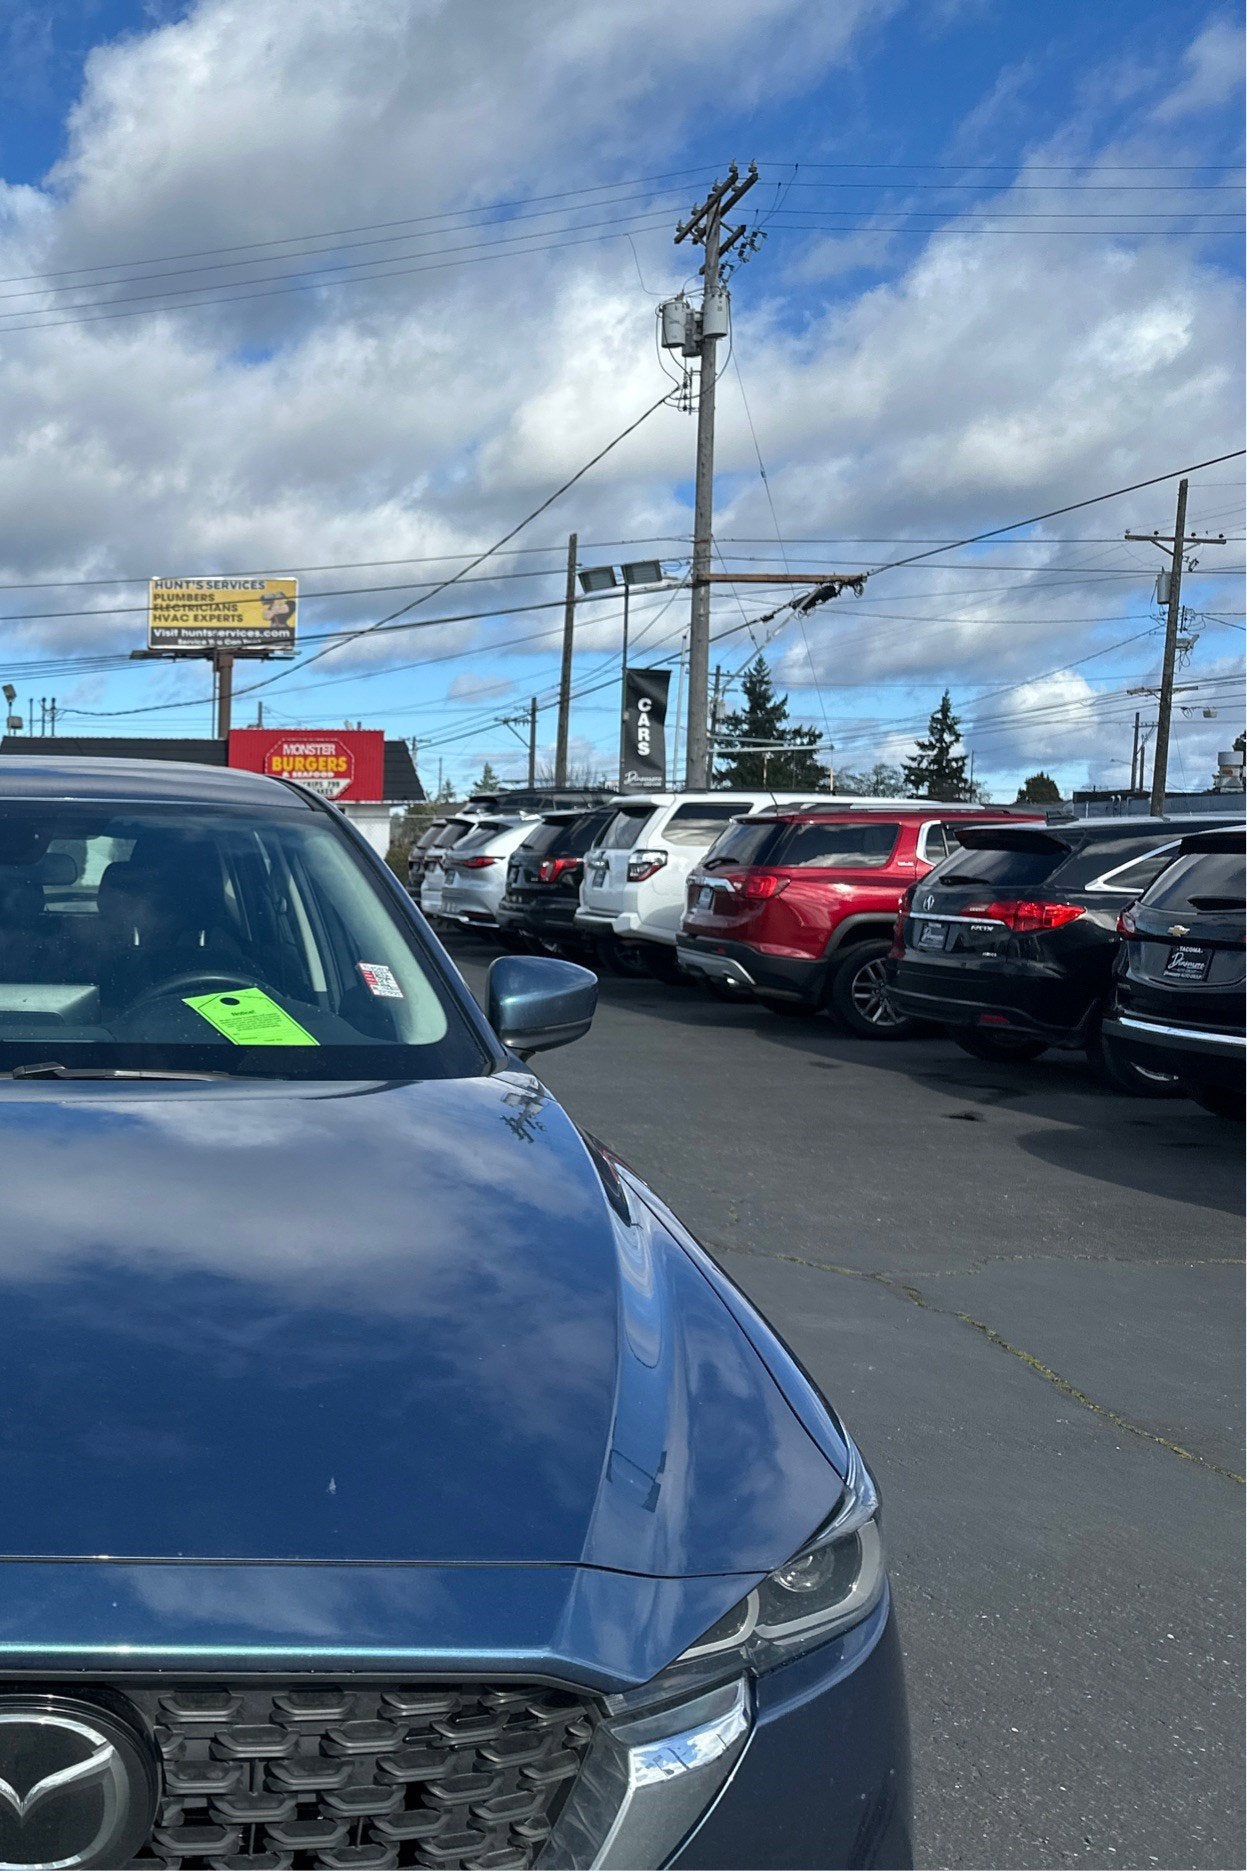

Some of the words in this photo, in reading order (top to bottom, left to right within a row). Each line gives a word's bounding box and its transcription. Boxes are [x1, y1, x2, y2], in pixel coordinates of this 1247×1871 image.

[154, 580, 203, 590] HUNT'S
[206, 580, 265, 590] SERVICES
[153, 593, 215, 602] PLUMBERS
[153, 603, 238, 612] ELECTRICIANS
[153, 613, 189, 623] HVAC
[193, 613, 244, 623] EXPERTS
[153, 628, 179, 638] Visit
[637, 697, 652, 756] CARS
[282, 743, 336, 756] MONSTER
[272, 755, 348, 772] BURGERS
[1179, 945, 1202, 954] TACOMA
